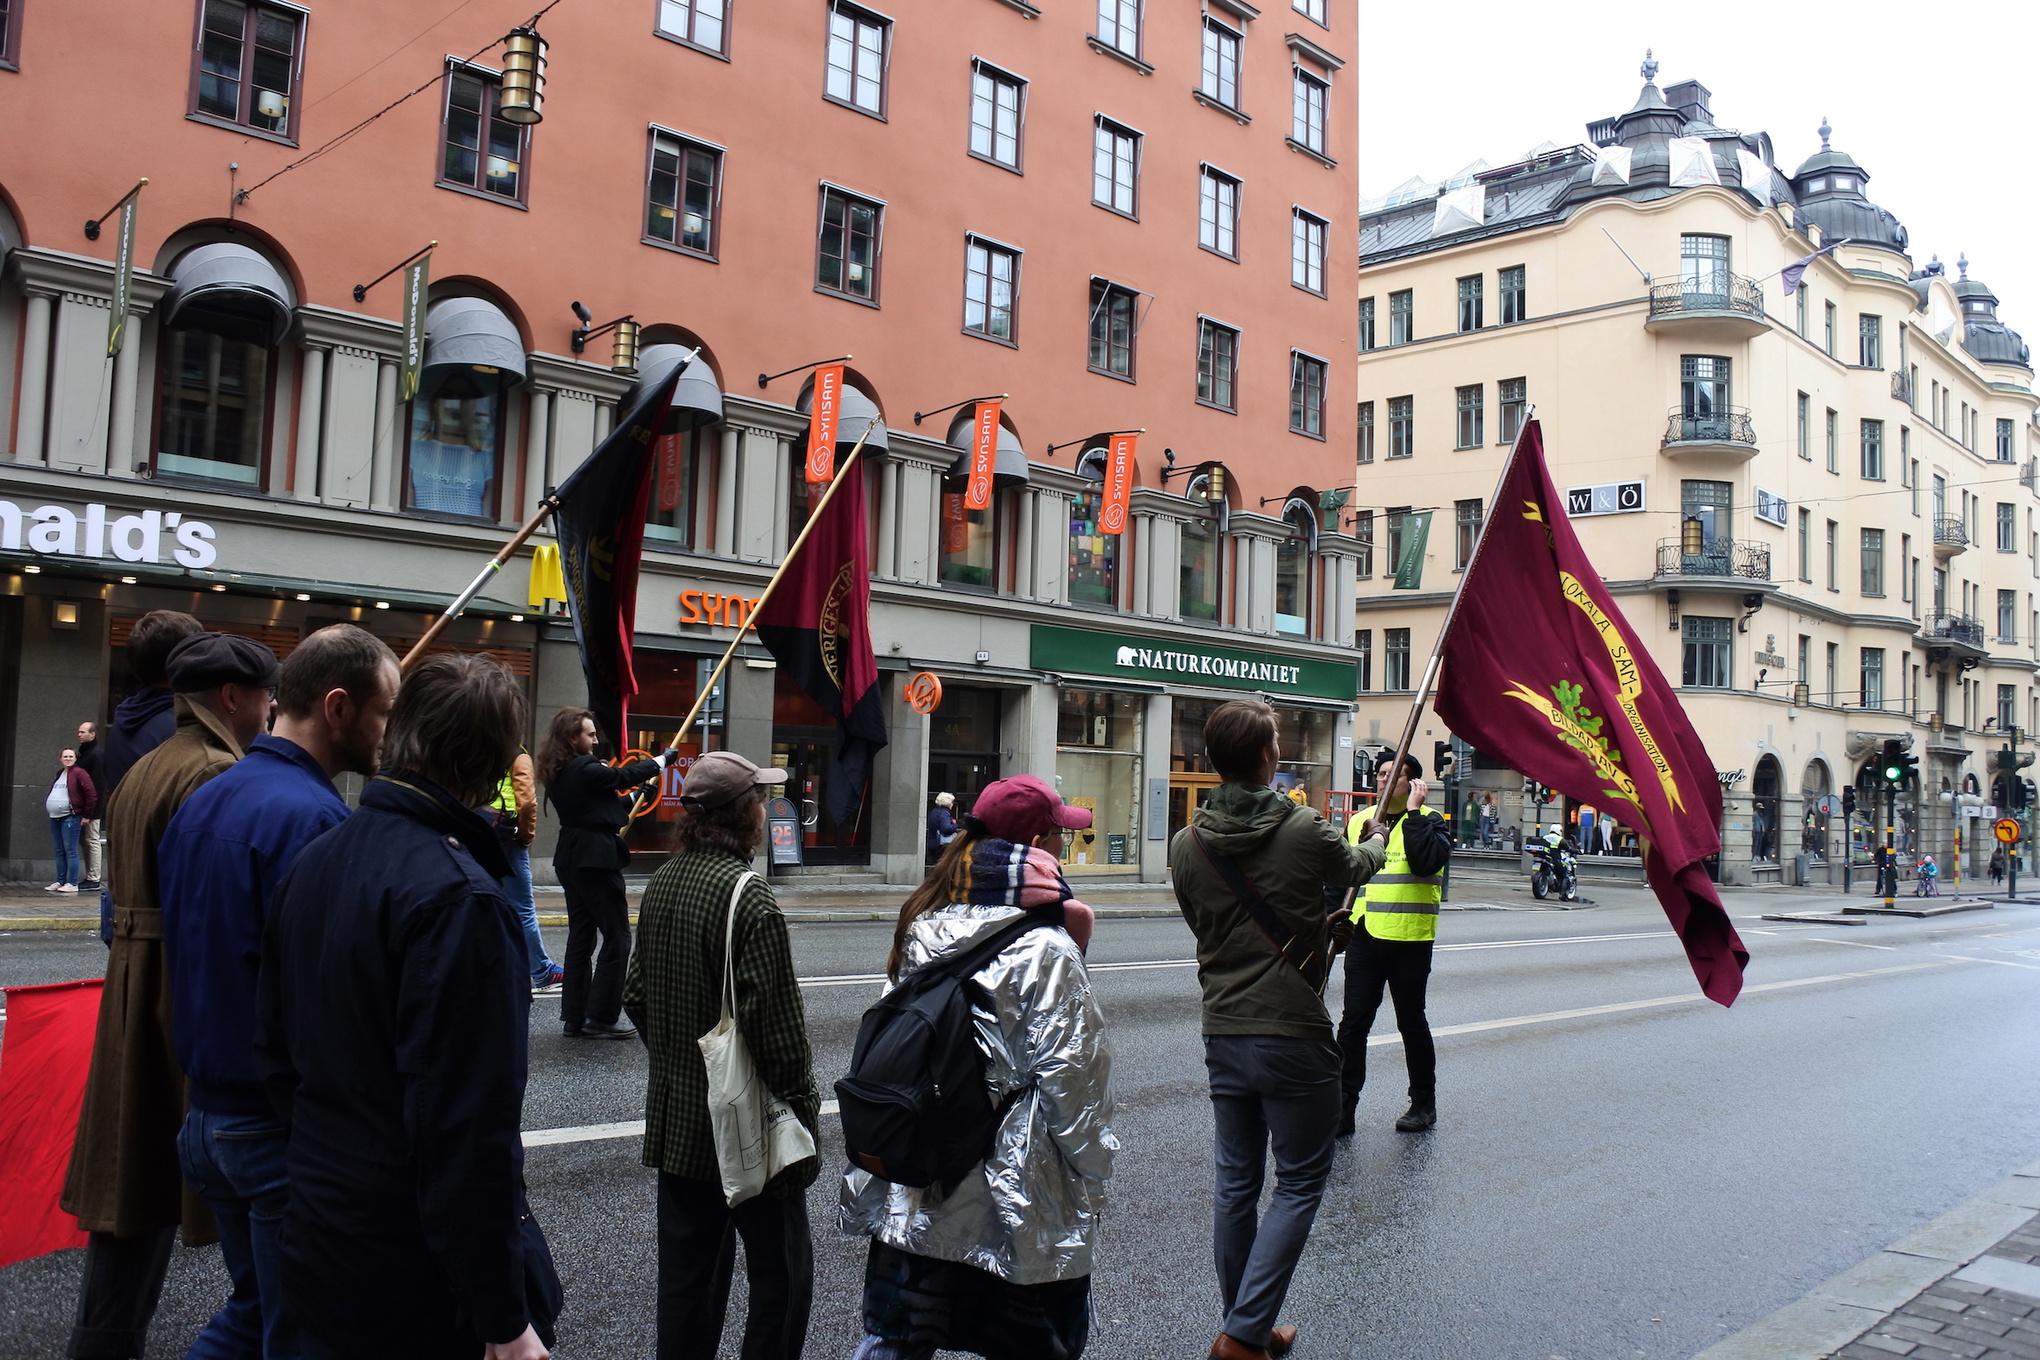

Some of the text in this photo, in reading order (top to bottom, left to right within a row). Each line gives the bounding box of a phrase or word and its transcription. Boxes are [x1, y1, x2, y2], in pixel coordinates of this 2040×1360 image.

[408, 266, 421, 367] McDonald's
[820, 372, 834, 442] SYNSAM
[977, 409, 992, 473] SYNSAM
[1113, 441, 1127, 500] SYNSAM
[1569, 485, 1638, 511] W & Ö
[1561, 576, 1611, 634] LOKALA
[1138, 648, 1300, 685] NATURKOMPANIET
[1551, 709, 1594, 749] BILDAD
[1598, 756, 1618, 778] AV
[1622, 702, 1669, 773] ORGANISATION
[771, 825, 796, 846] 25
